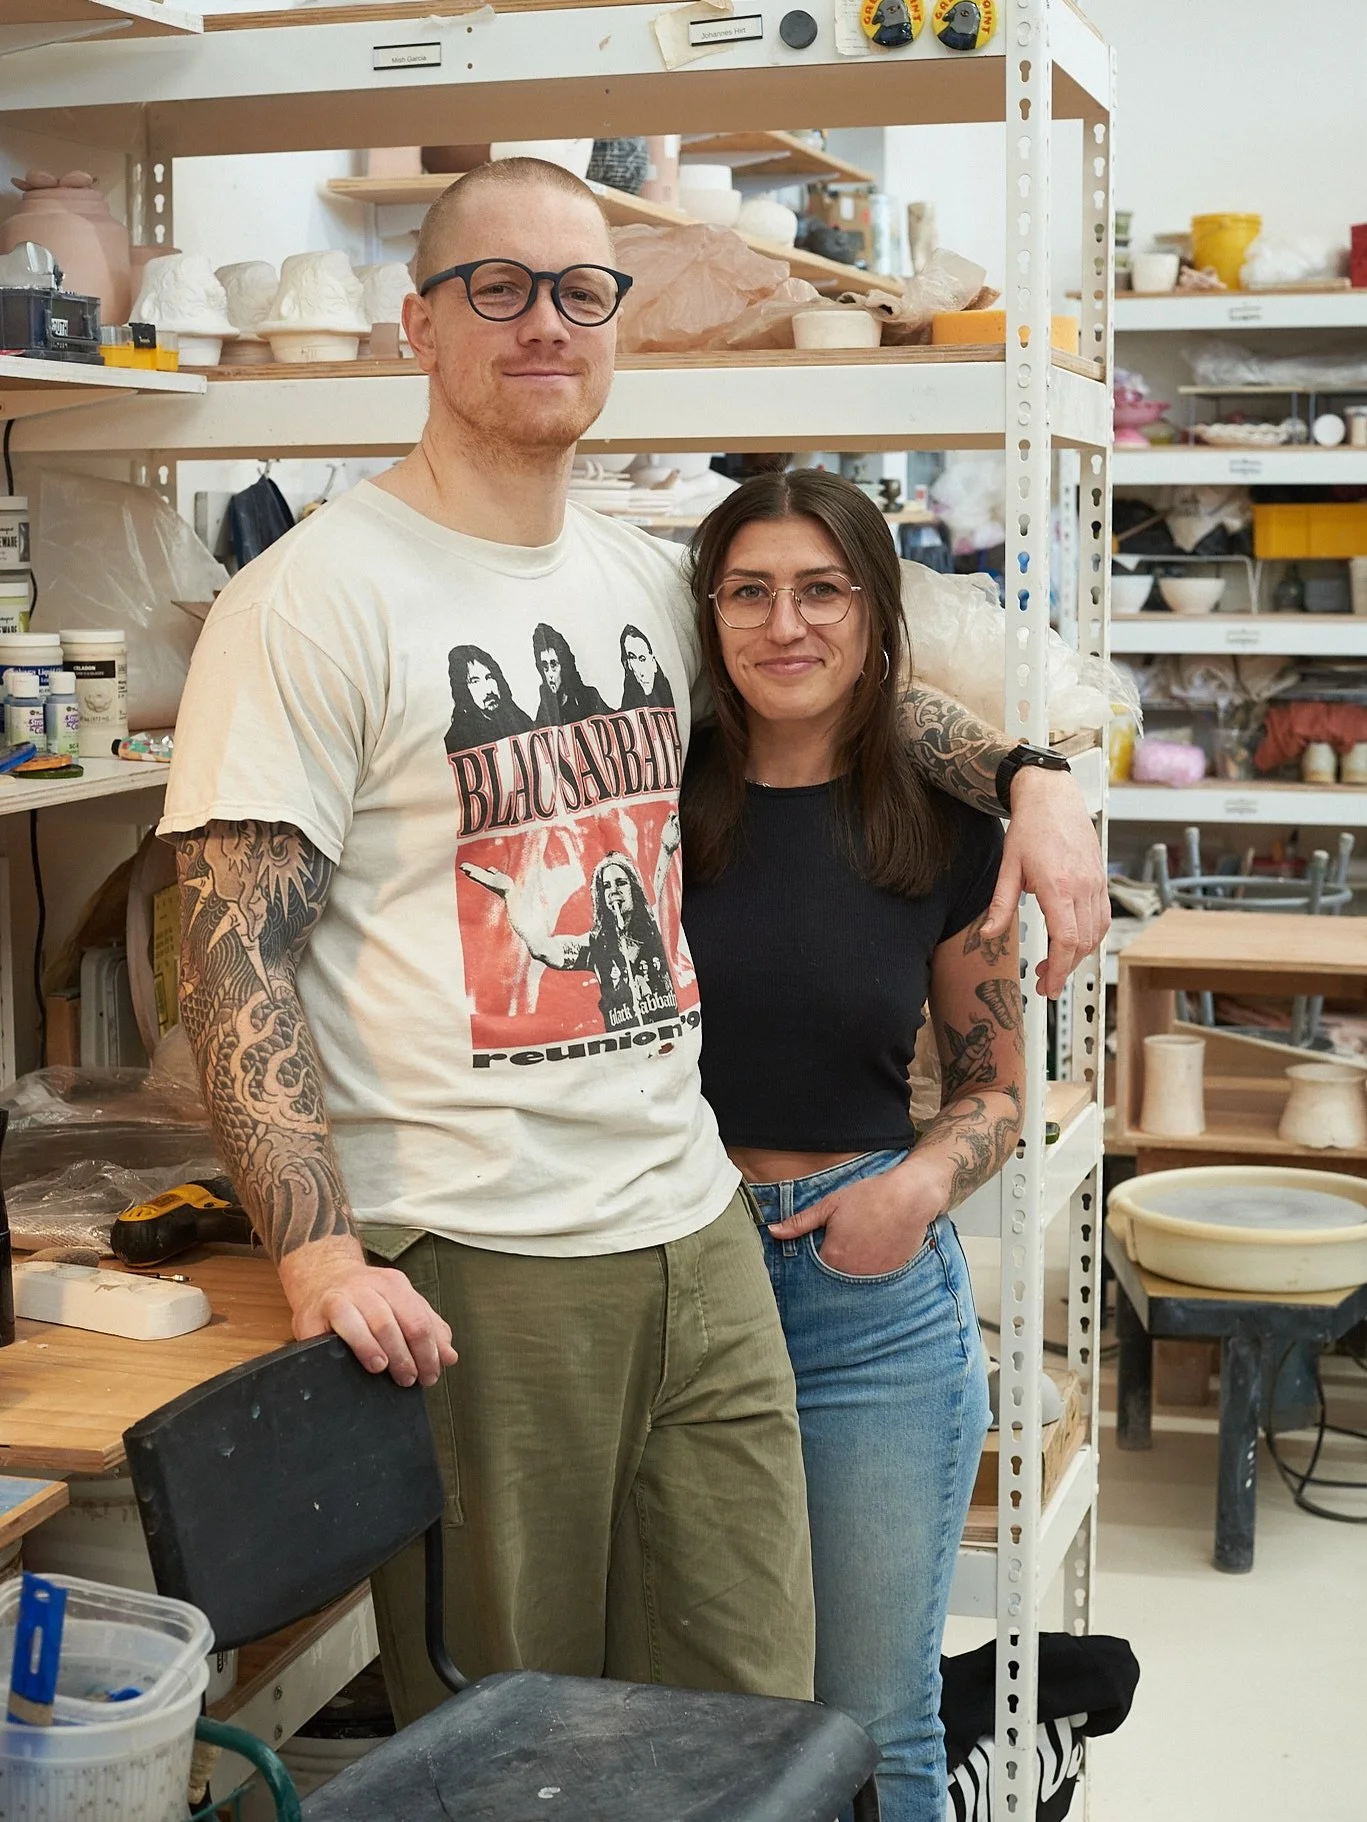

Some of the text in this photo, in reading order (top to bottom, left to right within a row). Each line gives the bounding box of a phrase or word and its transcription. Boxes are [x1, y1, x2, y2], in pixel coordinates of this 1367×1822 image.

[448, 726, 559, 839] BLAC
[609, 1003, 632, 1026] black
[473, 1023, 682, 1068] reunion
